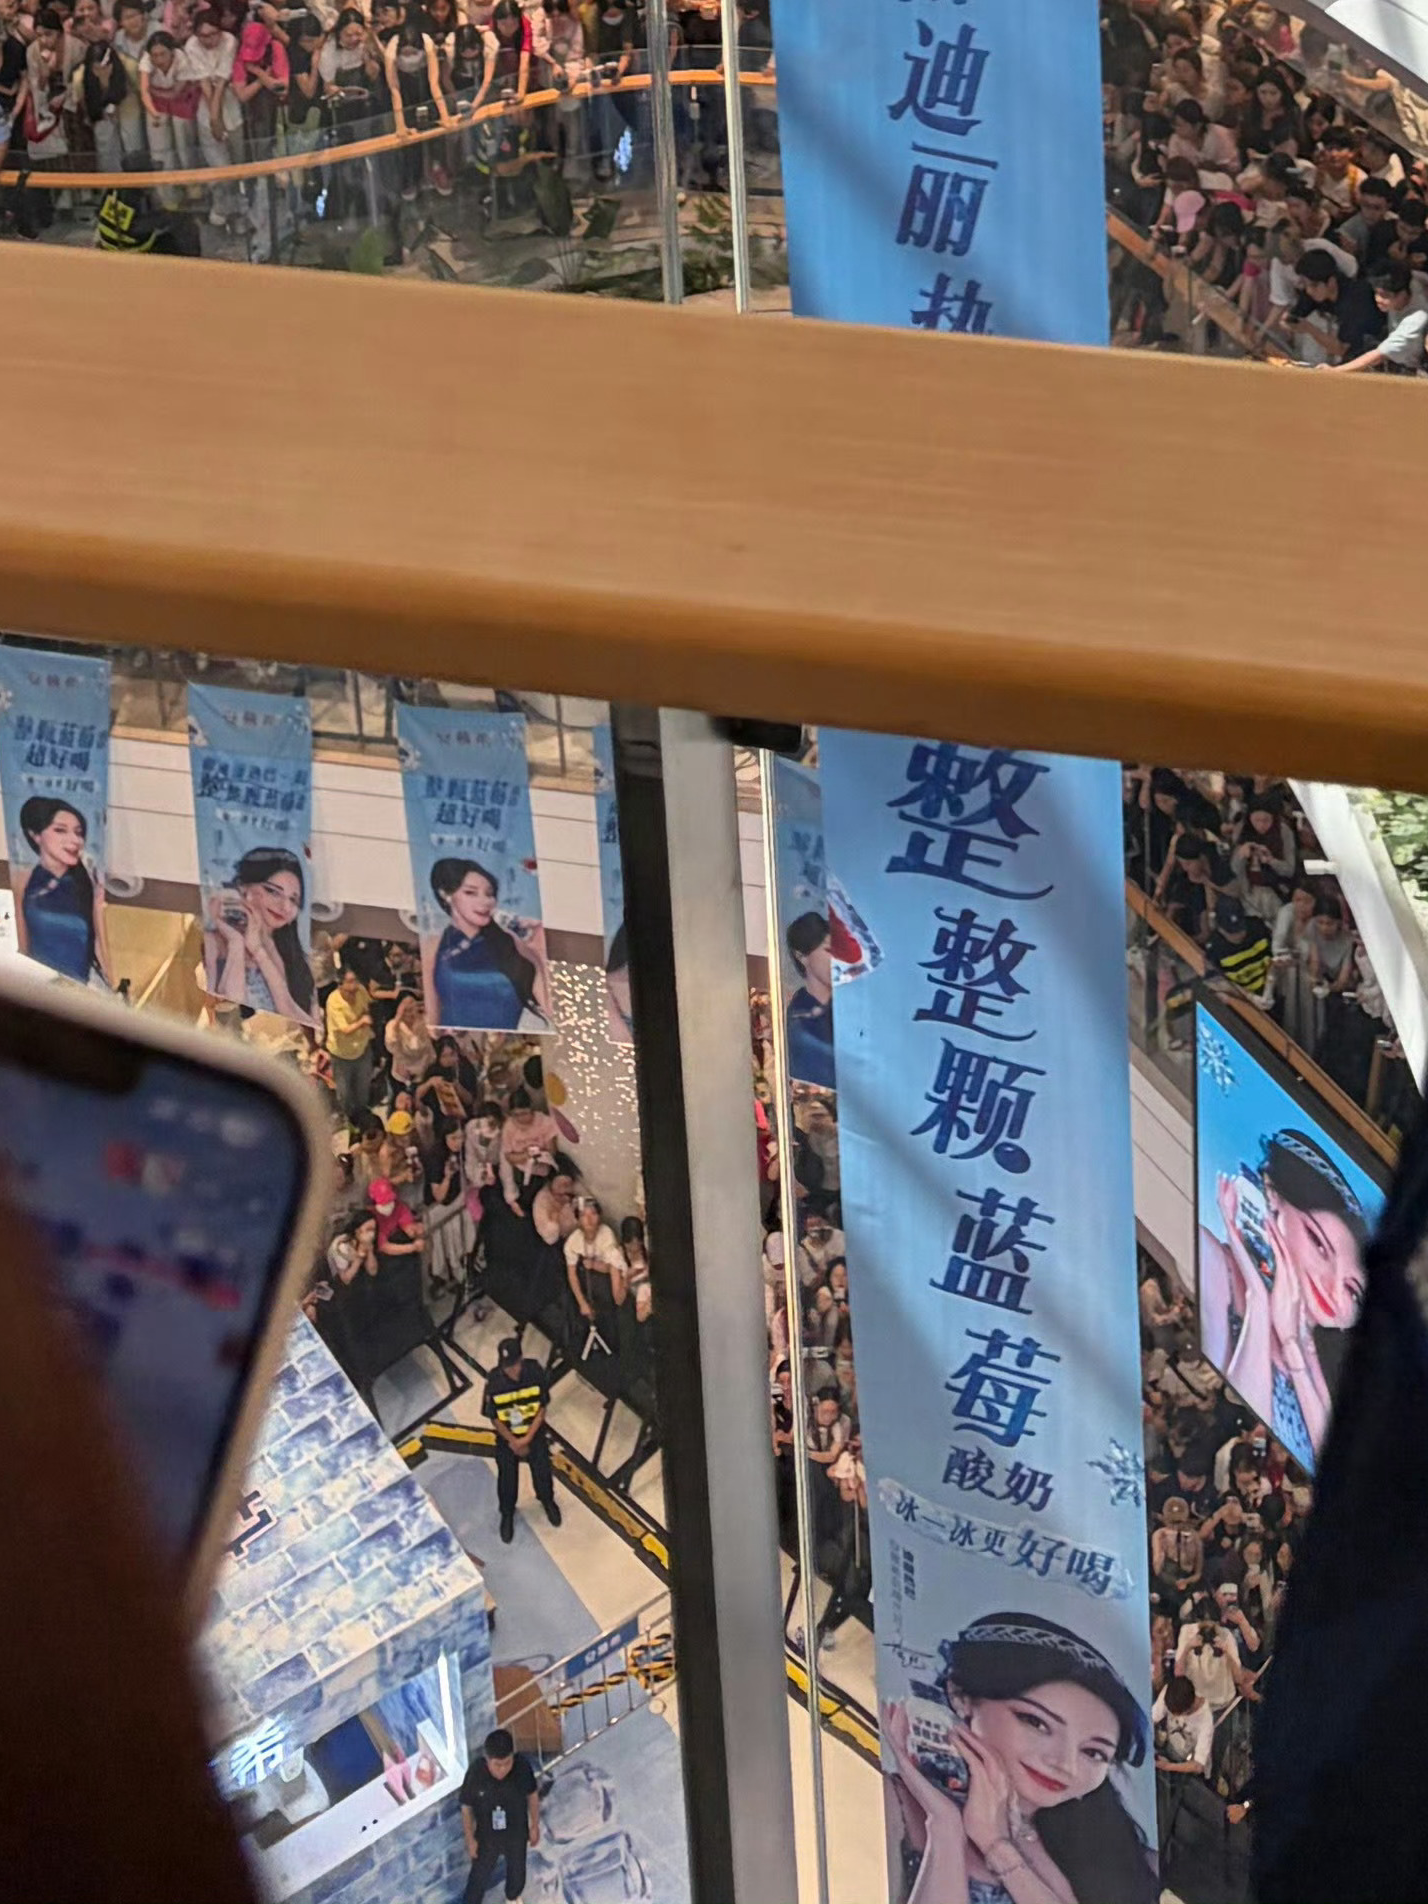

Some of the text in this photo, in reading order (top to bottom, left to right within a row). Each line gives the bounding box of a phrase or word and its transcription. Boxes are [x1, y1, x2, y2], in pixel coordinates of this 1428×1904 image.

[885, 742, 1060, 1447] 整整颗蓝莓
[942, 1445, 1055, 1512] 酸奶
[895, 1490, 1116, 1597] 冰一冰更好喝
